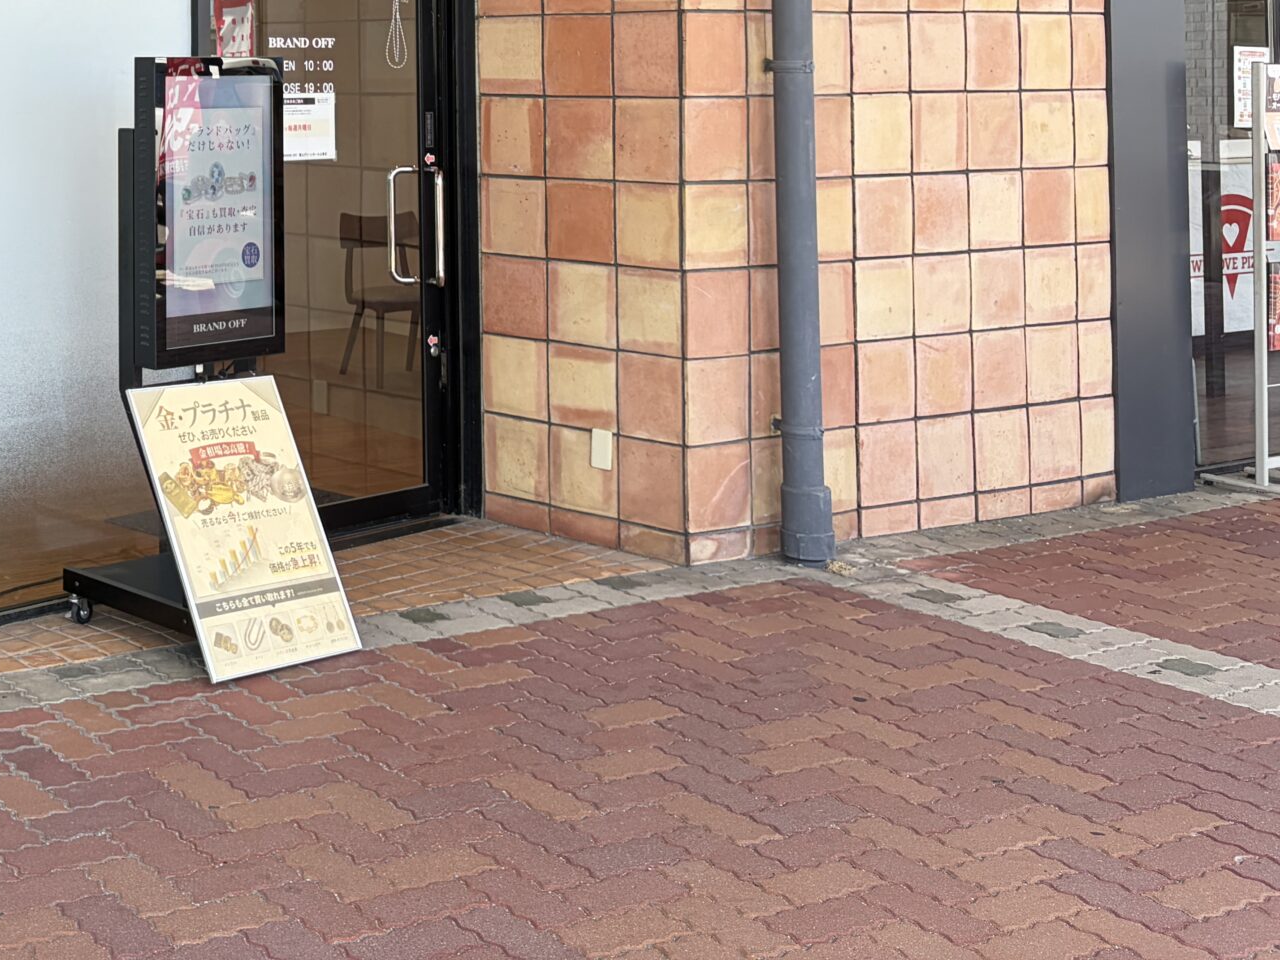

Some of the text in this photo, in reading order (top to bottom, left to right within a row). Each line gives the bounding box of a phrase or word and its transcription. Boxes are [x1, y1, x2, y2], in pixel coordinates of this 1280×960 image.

[268, 37, 336, 48] BRAND OFF
[283, 60, 296, 71] EN
[282, 82, 301, 93] OSE
[1191, 259, 1203, 273] W
[193, 319, 248, 333] BRAND OFF
